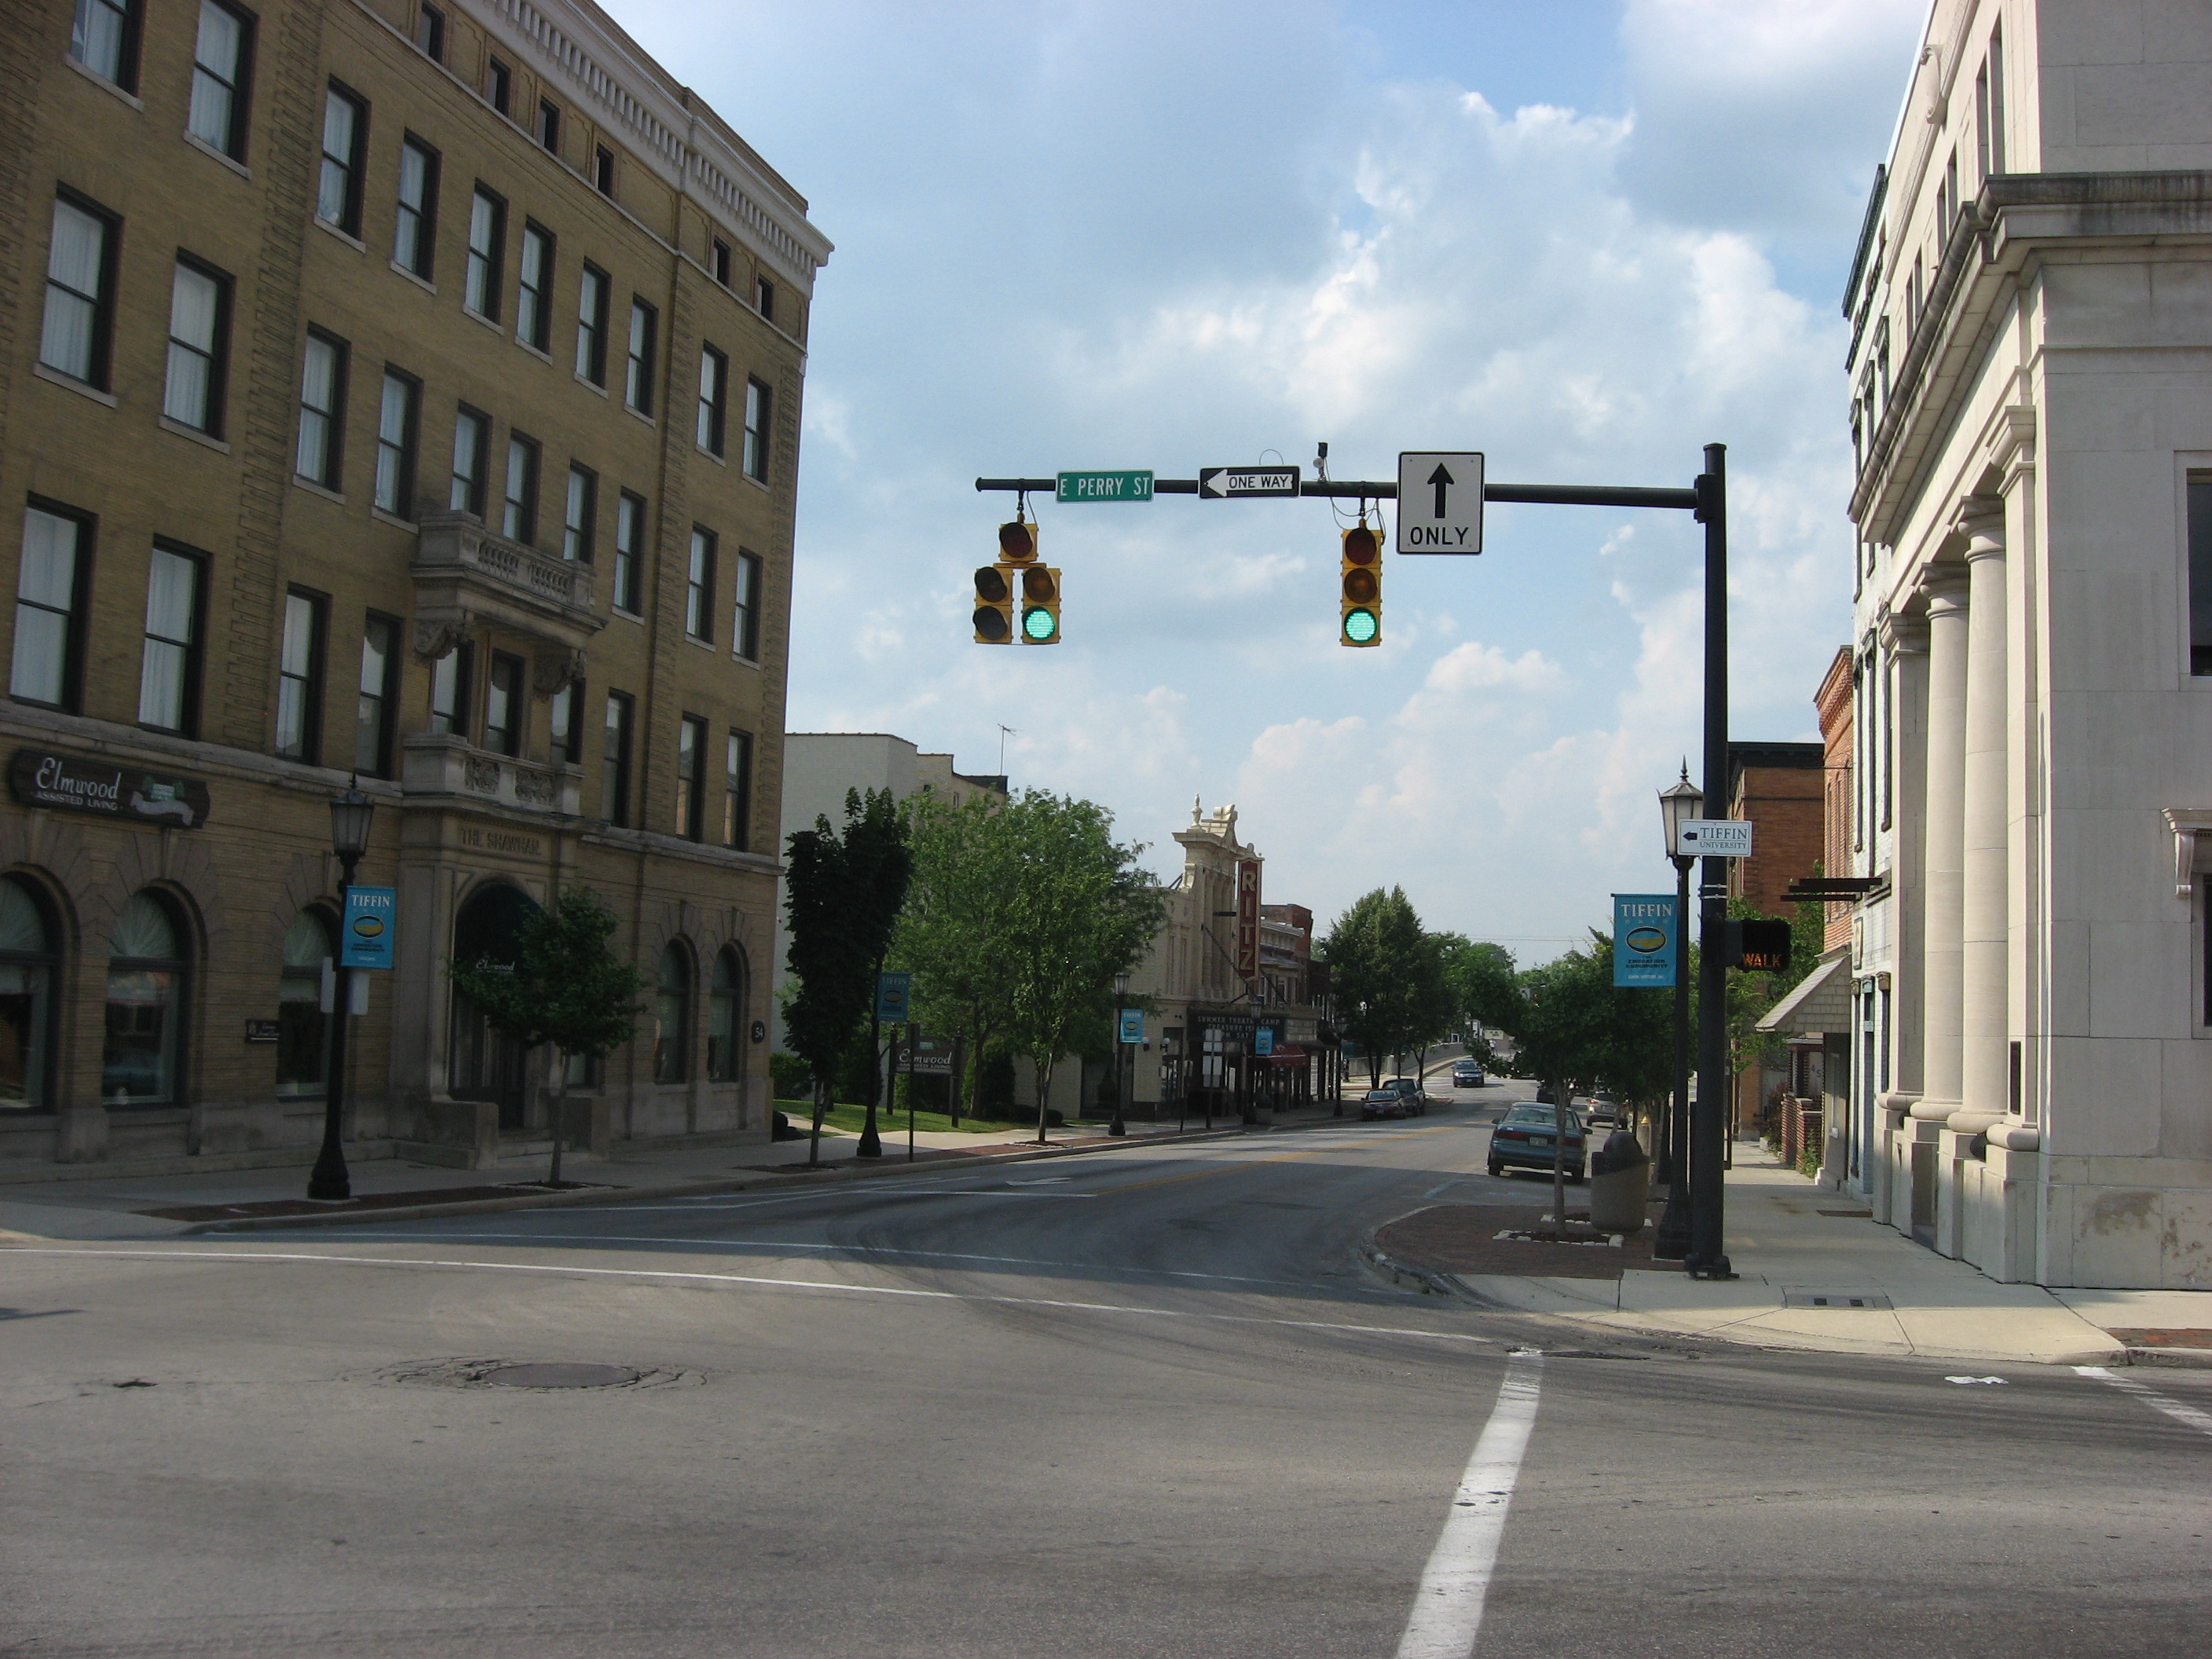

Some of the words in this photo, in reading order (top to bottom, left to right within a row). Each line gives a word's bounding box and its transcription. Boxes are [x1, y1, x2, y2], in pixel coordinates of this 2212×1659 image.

[1060, 478, 1068, 496] E
[1078, 478, 1124, 496] PERRY
[1133, 477, 1150, 495] ST
[1229, 476, 1256, 489] ONE
[1261, 475, 1289, 488] WAY
[1410, 526, 1469, 545] ONLY
[35, 756, 122, 800] Elmwood
[35, 791, 83, 806] ASSISTED
[87, 798, 118, 811] LIVING
[1700, 827, 1747, 840] TIFFIN
[351, 894, 390, 907] TIFFIN
[1621, 903, 1672, 917] TIFFIN
[1240, 870, 1256, 970] RITZ
[476, 958, 515, 971] Elwood
[1741, 953, 1782, 968] WALK
[755, 1027, 764, 1038] 54
[899, 1048, 952, 1064] Emwood
